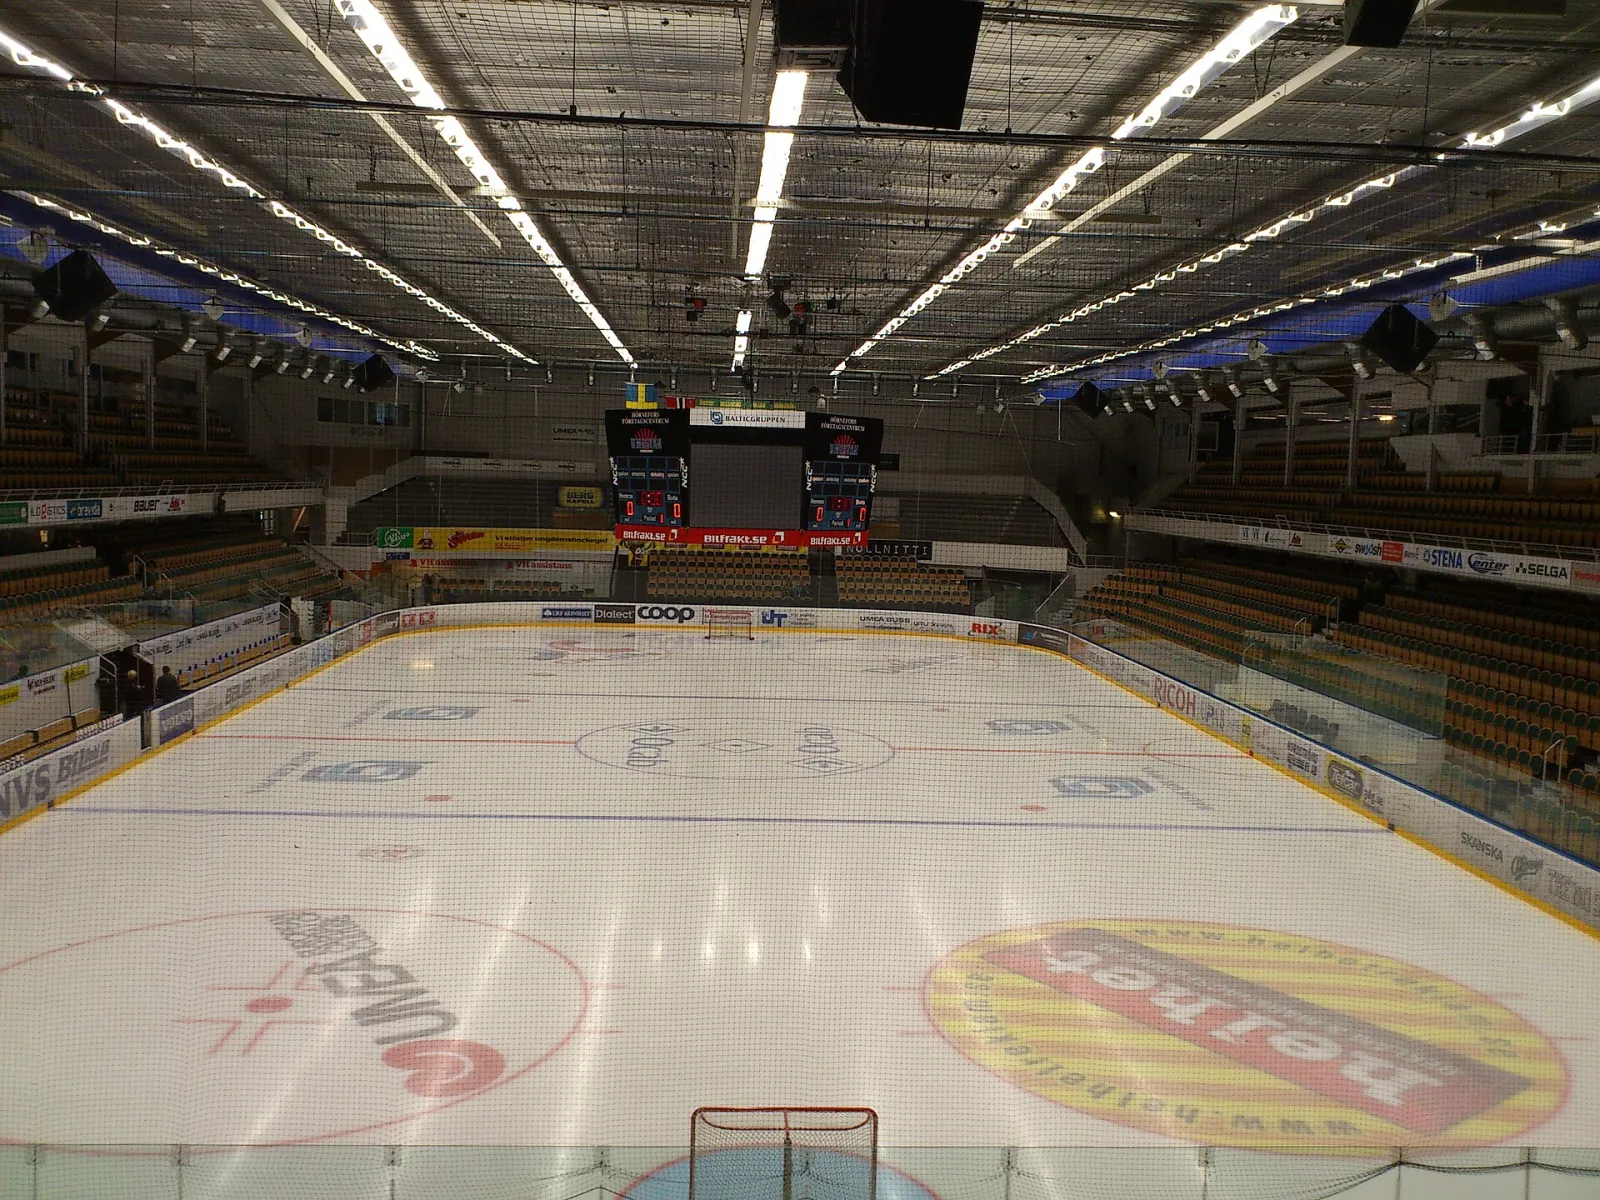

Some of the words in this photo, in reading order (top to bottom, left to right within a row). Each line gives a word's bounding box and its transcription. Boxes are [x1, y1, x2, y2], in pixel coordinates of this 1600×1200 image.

[725, 415, 786, 423] BALTICGRUPPEN
[626, 501, 634, 516] 0
[673, 503, 681, 518] 0
[816, 506, 824, 522] 0
[859, 507, 867, 522] 0
[623, 530, 666, 541] Bilfrakt.se
[704, 533, 768, 545] Bilfrakt.se
[810, 536, 851, 545] Bilfrakt.se
[515, 560, 530, 568] VH
[531, 561, 573, 569] assistans
[1431, 549, 1464, 569] STENA
[1528, 563, 1568, 579] SELGA
[595, 609, 635, 619] Dialect
[637, 606, 695, 624] coop
[971, 622, 999, 635] RIX
[1154, 675, 1196, 719] RICOH
[1460, 831, 1503, 863] SKANSKA
